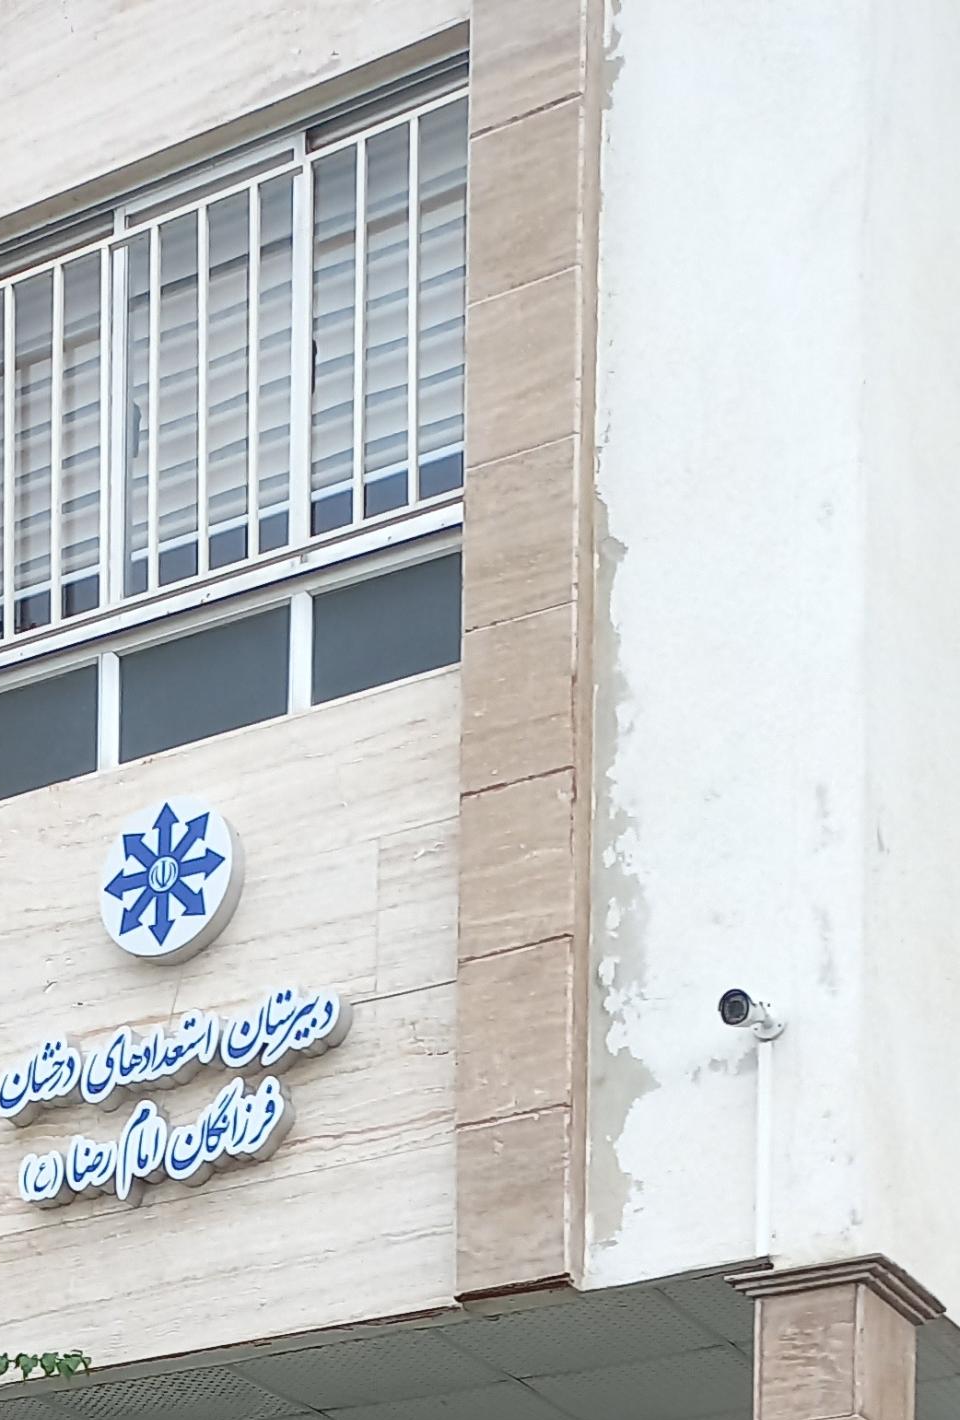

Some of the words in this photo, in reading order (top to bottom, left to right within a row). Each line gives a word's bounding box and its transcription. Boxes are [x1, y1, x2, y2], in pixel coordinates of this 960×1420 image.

[86, 1017, 213, 1095] استعدادهای
[228, 989, 334, 1058] دبیرستان
[71, 1144, 114, 1183] رضا
[120, 1104, 160, 1194] امام
[170, 1083, 276, 1171] فرزانگان
